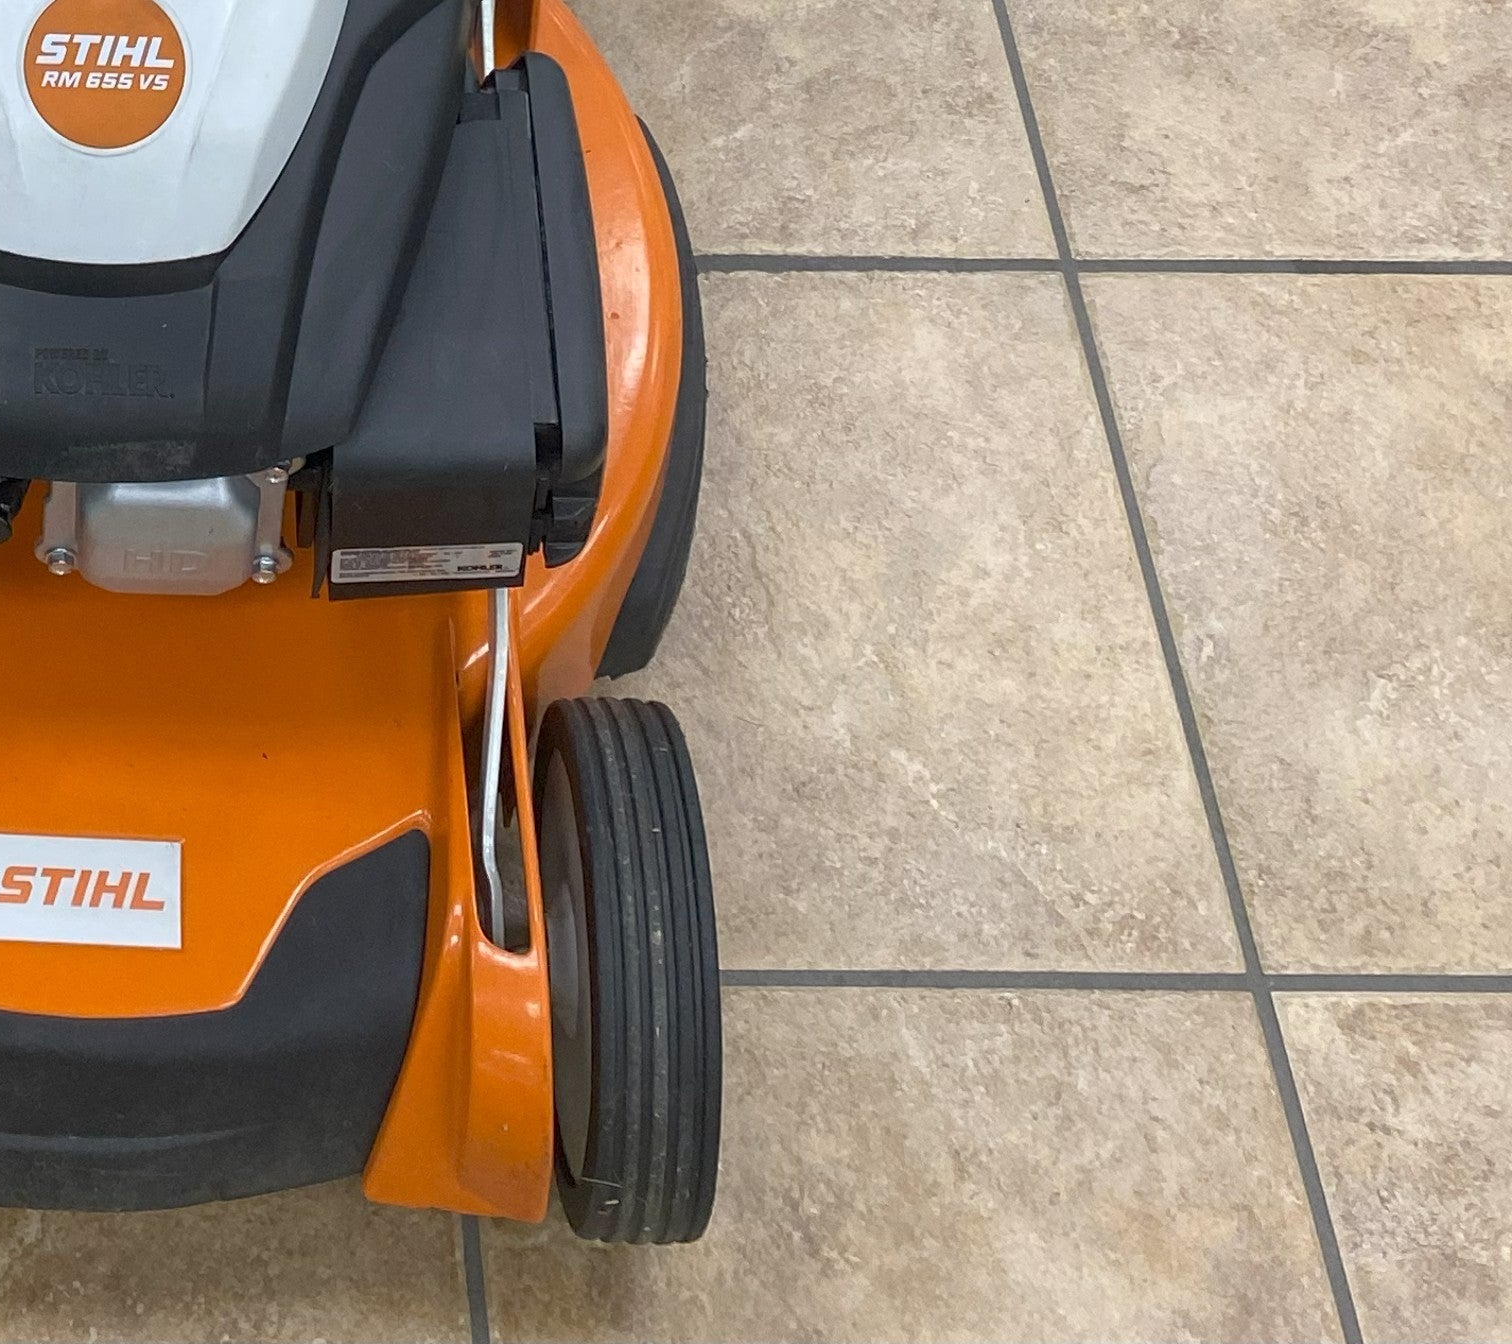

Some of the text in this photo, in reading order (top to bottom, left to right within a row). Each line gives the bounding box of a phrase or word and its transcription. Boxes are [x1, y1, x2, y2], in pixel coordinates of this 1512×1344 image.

[35, 33, 175, 69] STIHL
[41, 70, 170, 91] RM 655 VS
